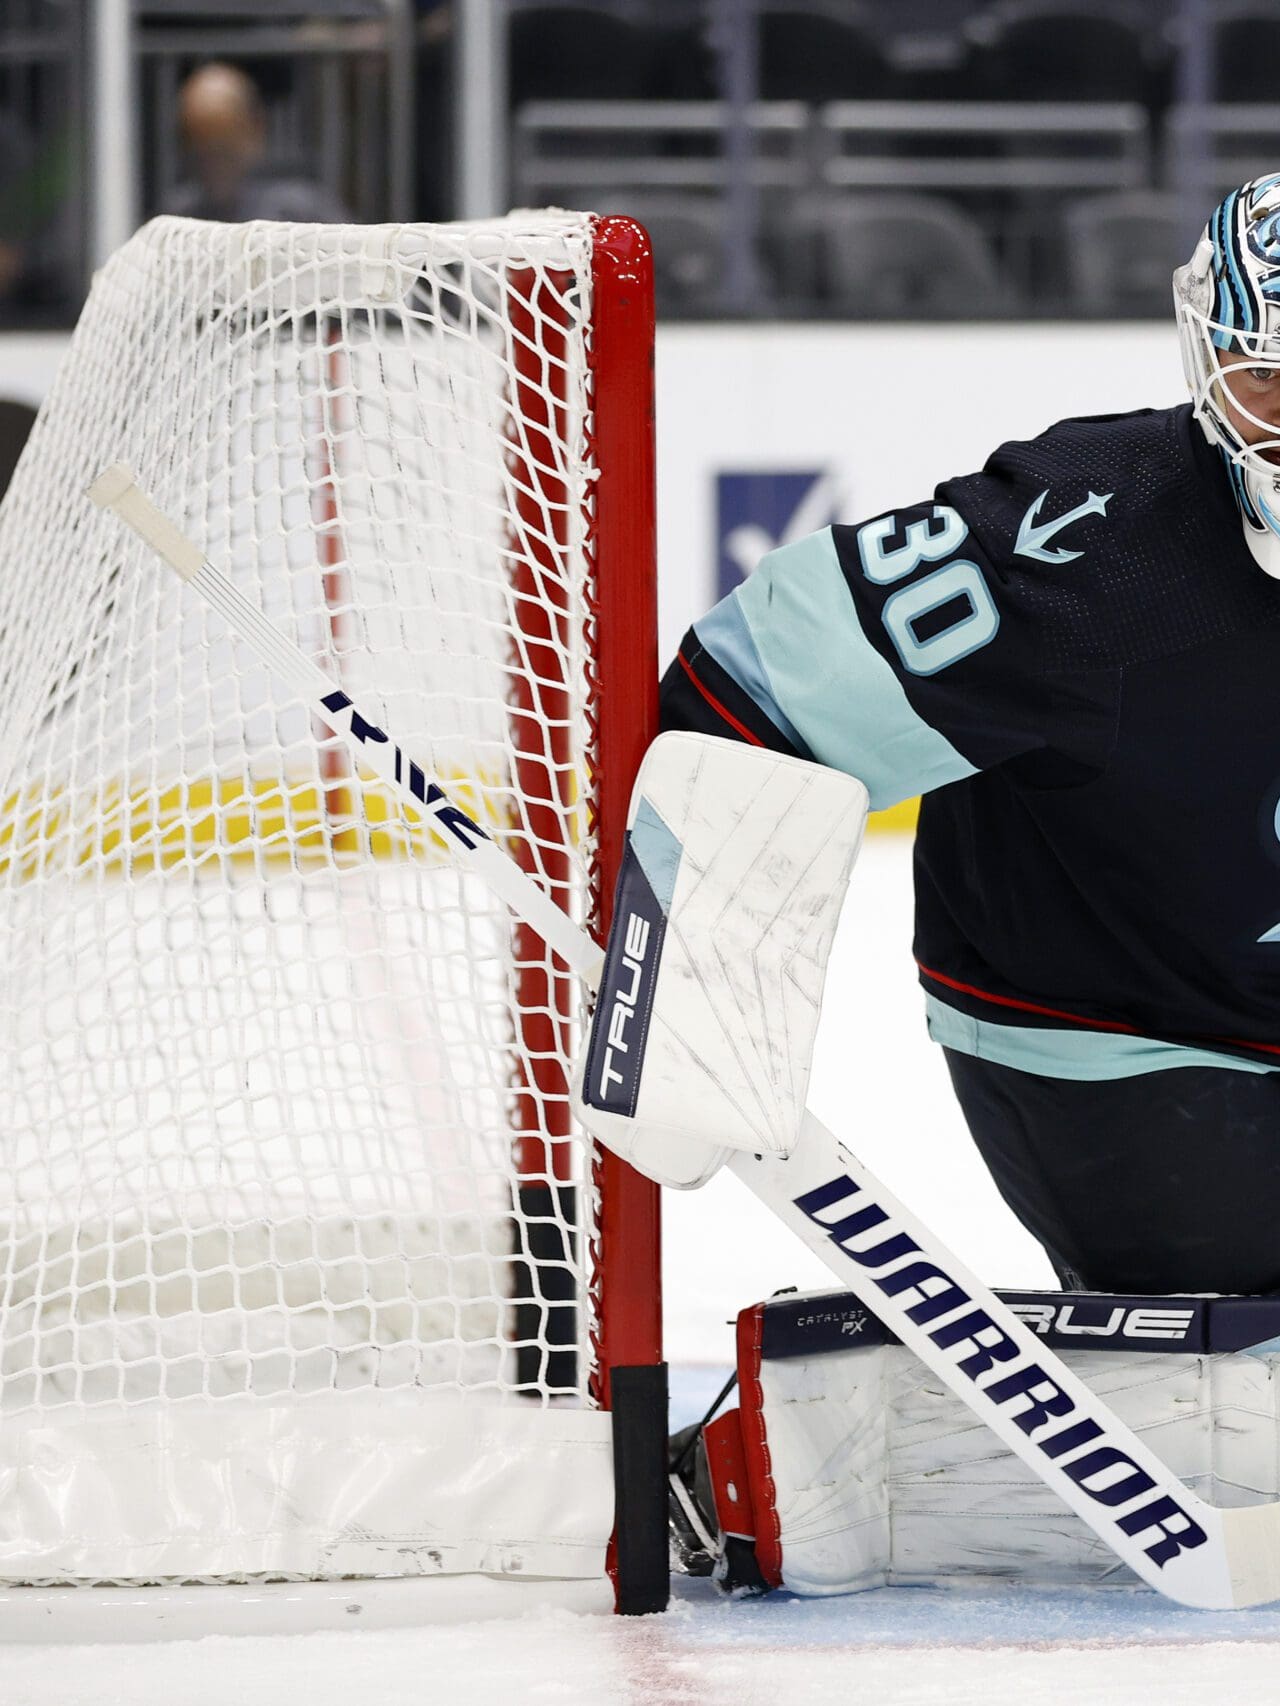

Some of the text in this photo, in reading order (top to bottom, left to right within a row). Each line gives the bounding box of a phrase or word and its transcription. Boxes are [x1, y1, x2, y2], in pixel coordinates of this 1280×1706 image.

[857, 505, 1000, 677] 30
[600, 912, 650, 1100] TRUE
[797, 1309, 864, 1327] CATALYST
[841, 1316, 868, 1336] PX
[1007, 1303, 1195, 1340] RUE
[793, 1174, 1208, 1569] WARRIOR
